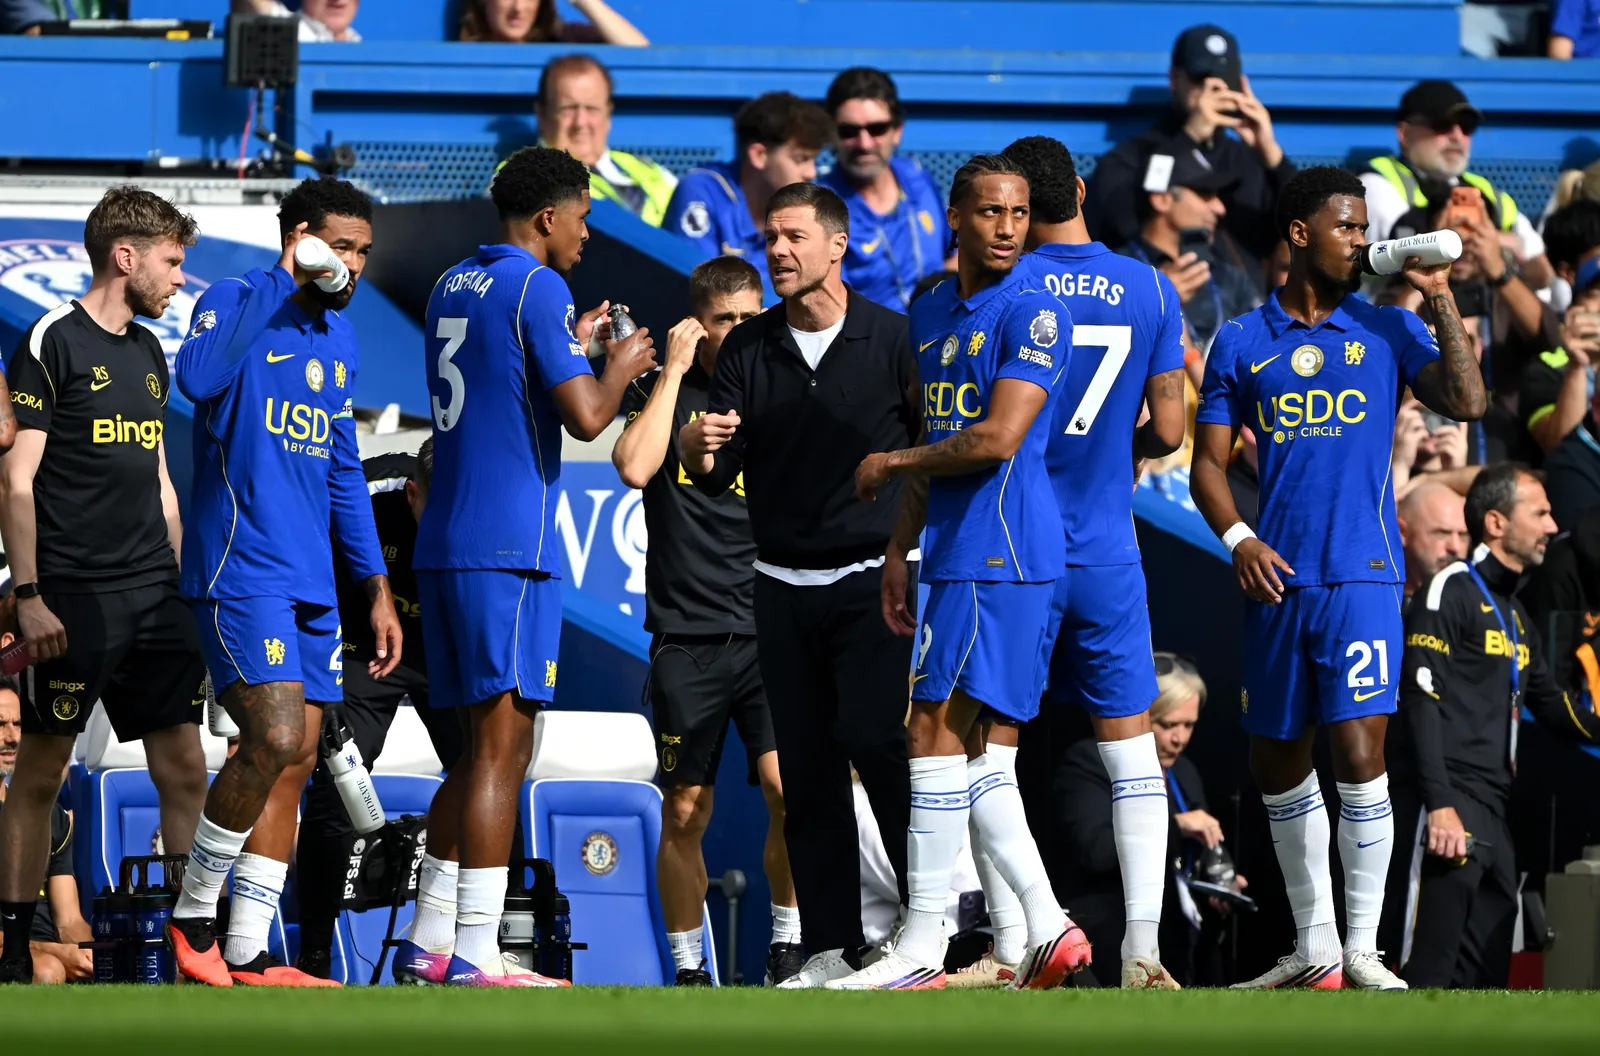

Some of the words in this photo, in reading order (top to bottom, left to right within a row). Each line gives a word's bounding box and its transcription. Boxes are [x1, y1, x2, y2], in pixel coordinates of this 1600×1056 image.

[443, 270, 494, 299] FOFANA
[1044, 273, 1125, 306] OGERS
[1020, 345, 1031, 355] No
[1031, 349, 1051, 362] room
[92, 366, 109, 380] RS
[432, 317, 469, 432] 3
[1064, 325, 1132, 435] 7
[9, 391, 43, 411] GORA
[1256, 389, 1367, 433] USDC
[265, 397, 338, 446] USD
[932, 420, 963, 431] CIRCLE
[1301, 426, 1342, 437] CIRCLE
[290, 442, 305, 453] BY
[306, 445, 330, 459] CIRCLE
[1345, 639, 1389, 688] 21
[356, 776, 380, 822] HYDRATE
[344, 854, 363, 900] IFS.ai
